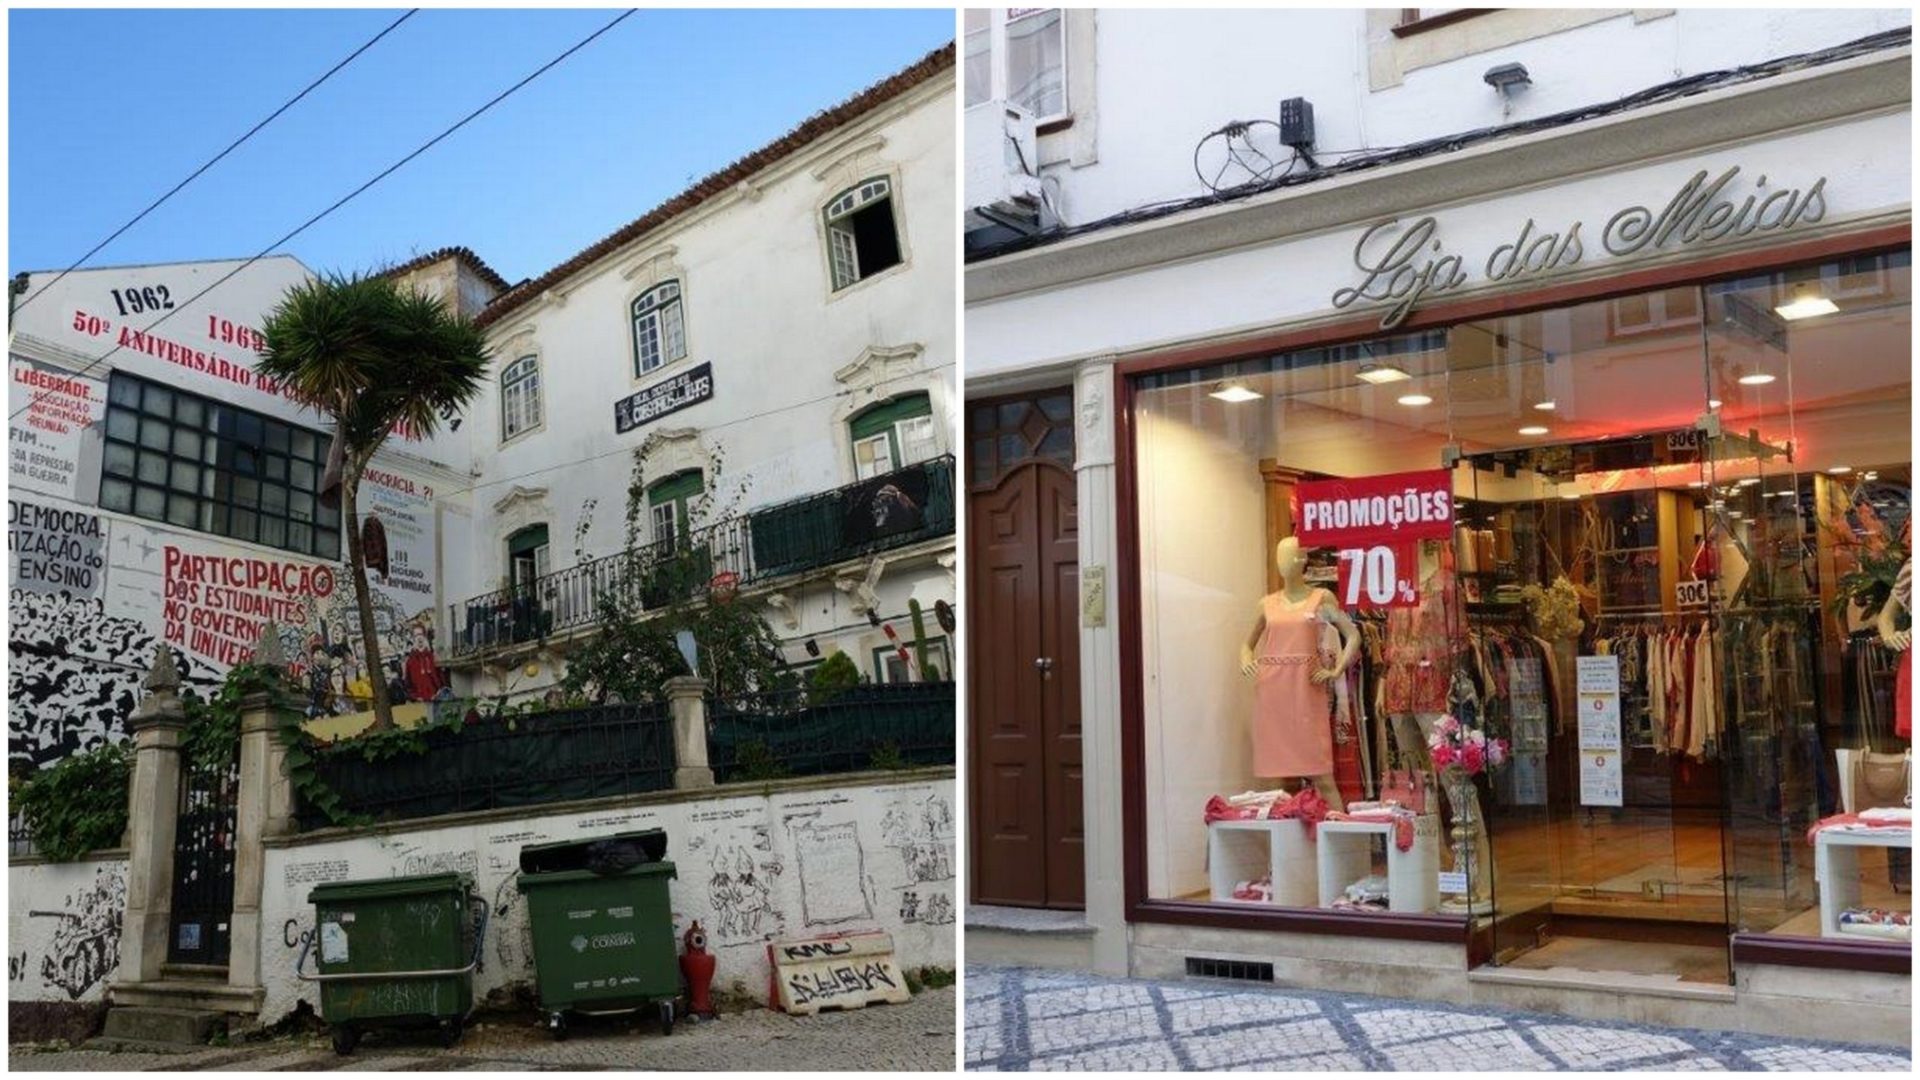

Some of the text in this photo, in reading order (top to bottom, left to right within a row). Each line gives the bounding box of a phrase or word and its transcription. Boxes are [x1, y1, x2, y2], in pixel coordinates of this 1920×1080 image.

[1332, 165, 1828, 329] Loja das Meias
[111, 284, 174, 316] 1962
[117, 326, 250, 385] ANIVERSÁRIO
[1669, 431, 1697, 448] 30€
[1304, 488, 1449, 531] PROMOÇÕES
[20, 559, 92, 589] ENSINO
[85, 549, 103, 569] do
[164, 545, 334, 599] PARTICIPAÇÃO
[165, 579, 306, 624] DOS ESTUDANTES
[1678, 581, 1707, 604] 30€
[163, 600, 187, 622] NO
[165, 621, 185, 646] DA
